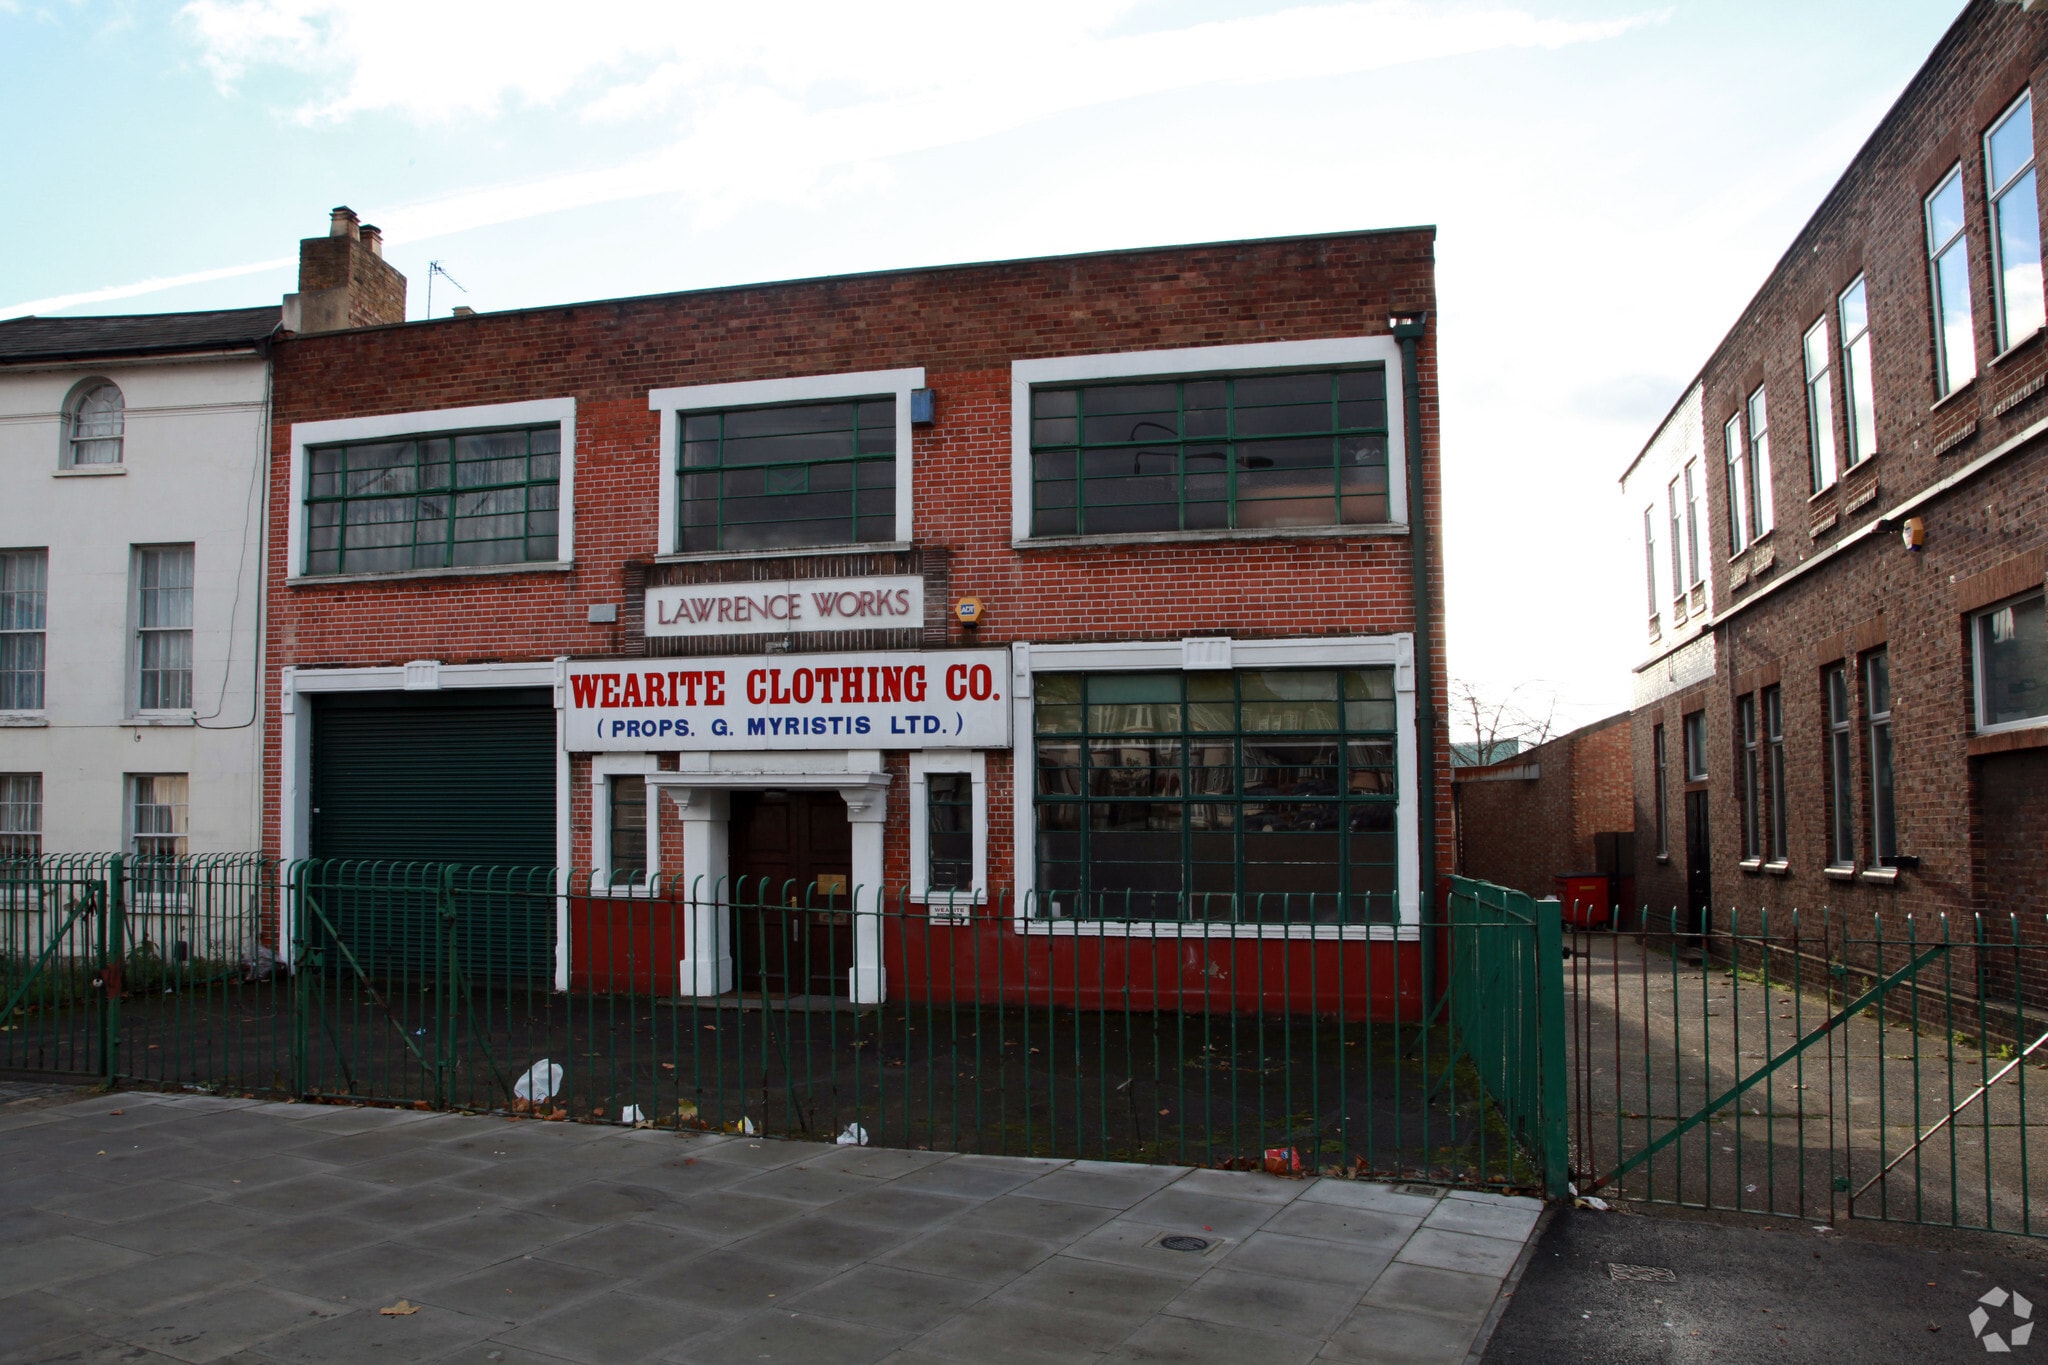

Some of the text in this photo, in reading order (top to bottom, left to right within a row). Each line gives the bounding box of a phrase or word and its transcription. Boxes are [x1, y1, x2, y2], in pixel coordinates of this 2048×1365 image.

[657, 588, 910, 625] LAWRENCE WORKS
[961, 605, 975, 613] ADT
[570, 663, 1001, 709] WEARITE CLOTHING CO.
[711, 717, 735, 737] G.
[747, 715, 871, 736] MYRISTIS
